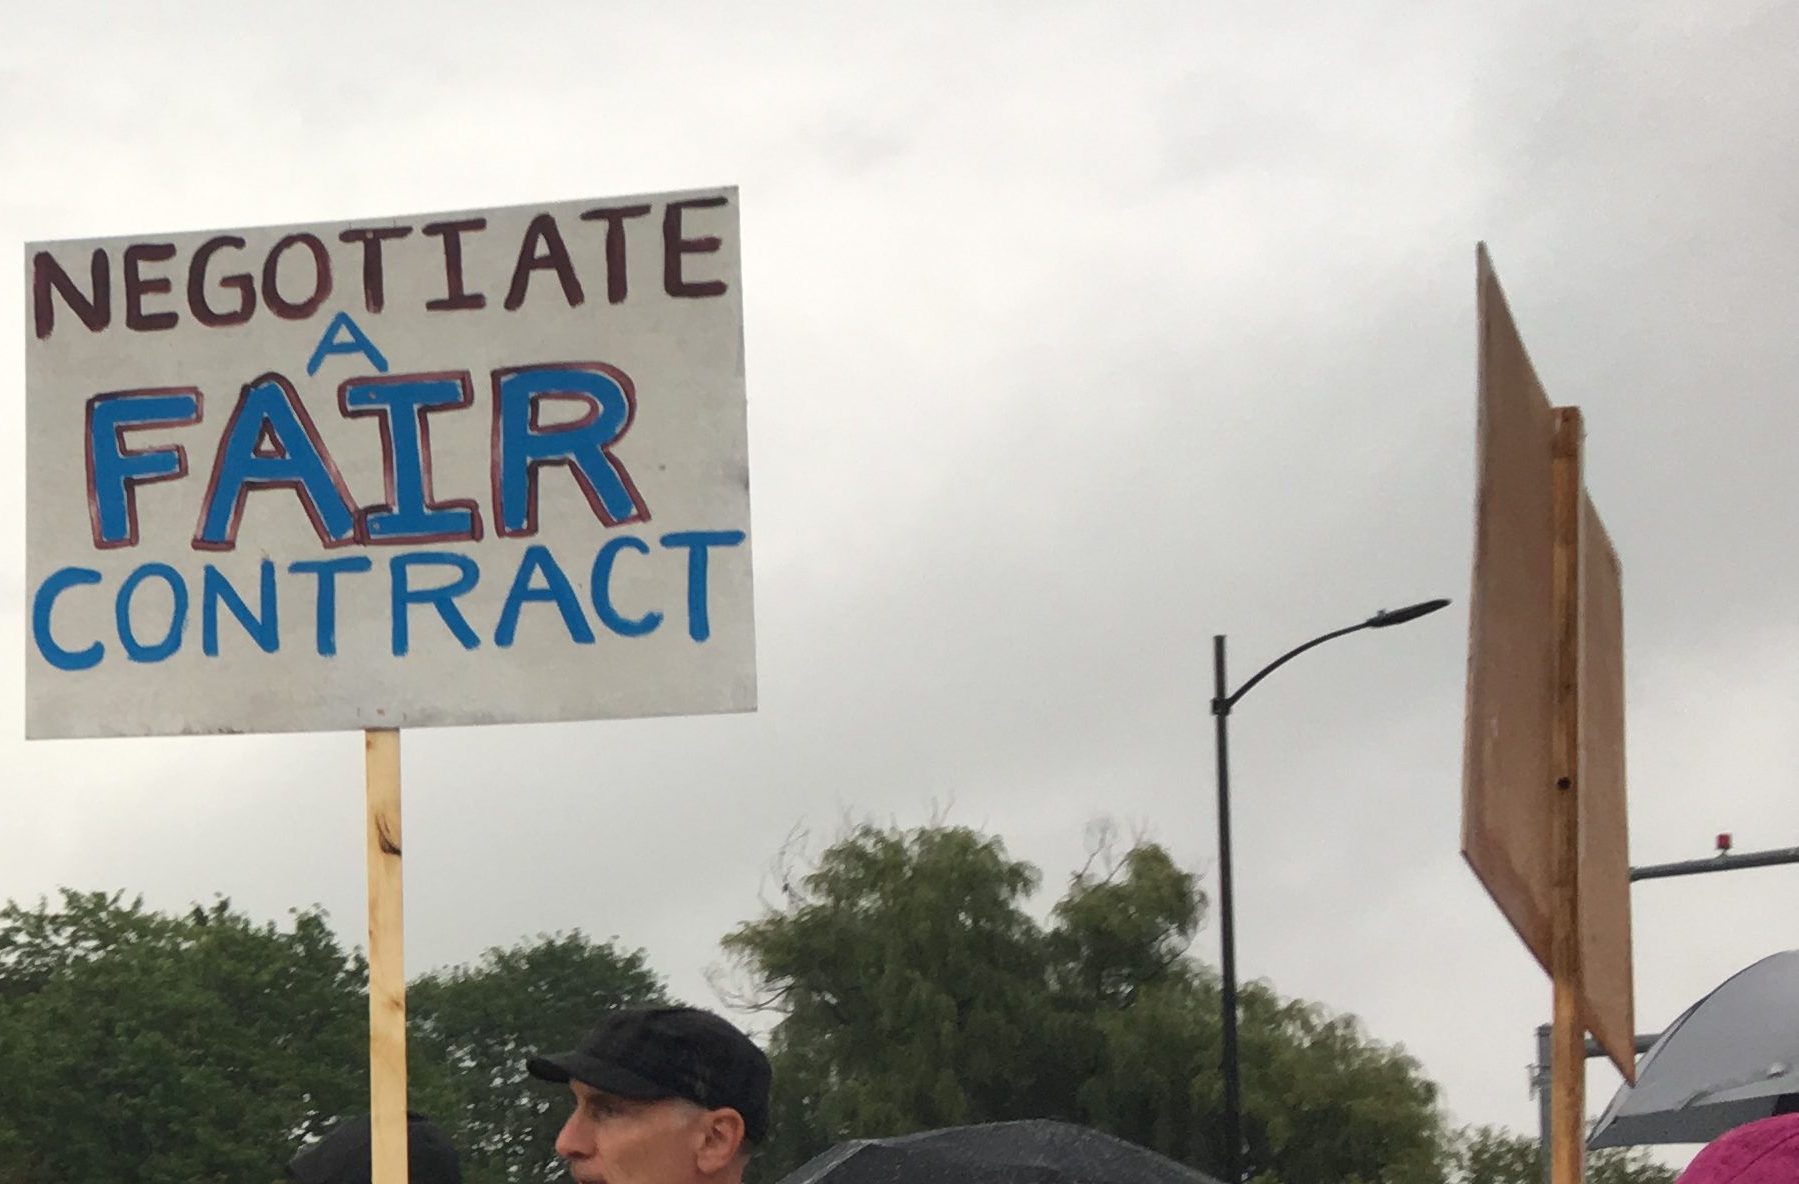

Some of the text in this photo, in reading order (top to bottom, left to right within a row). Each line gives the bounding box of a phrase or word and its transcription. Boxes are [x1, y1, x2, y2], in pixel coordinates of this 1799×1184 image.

[33, 197, 729, 340] NEGOTIATE
[306, 312, 389, 376] A
[85, 362, 652, 550] FAIR
[32, 530, 746, 672] CONTRACT
